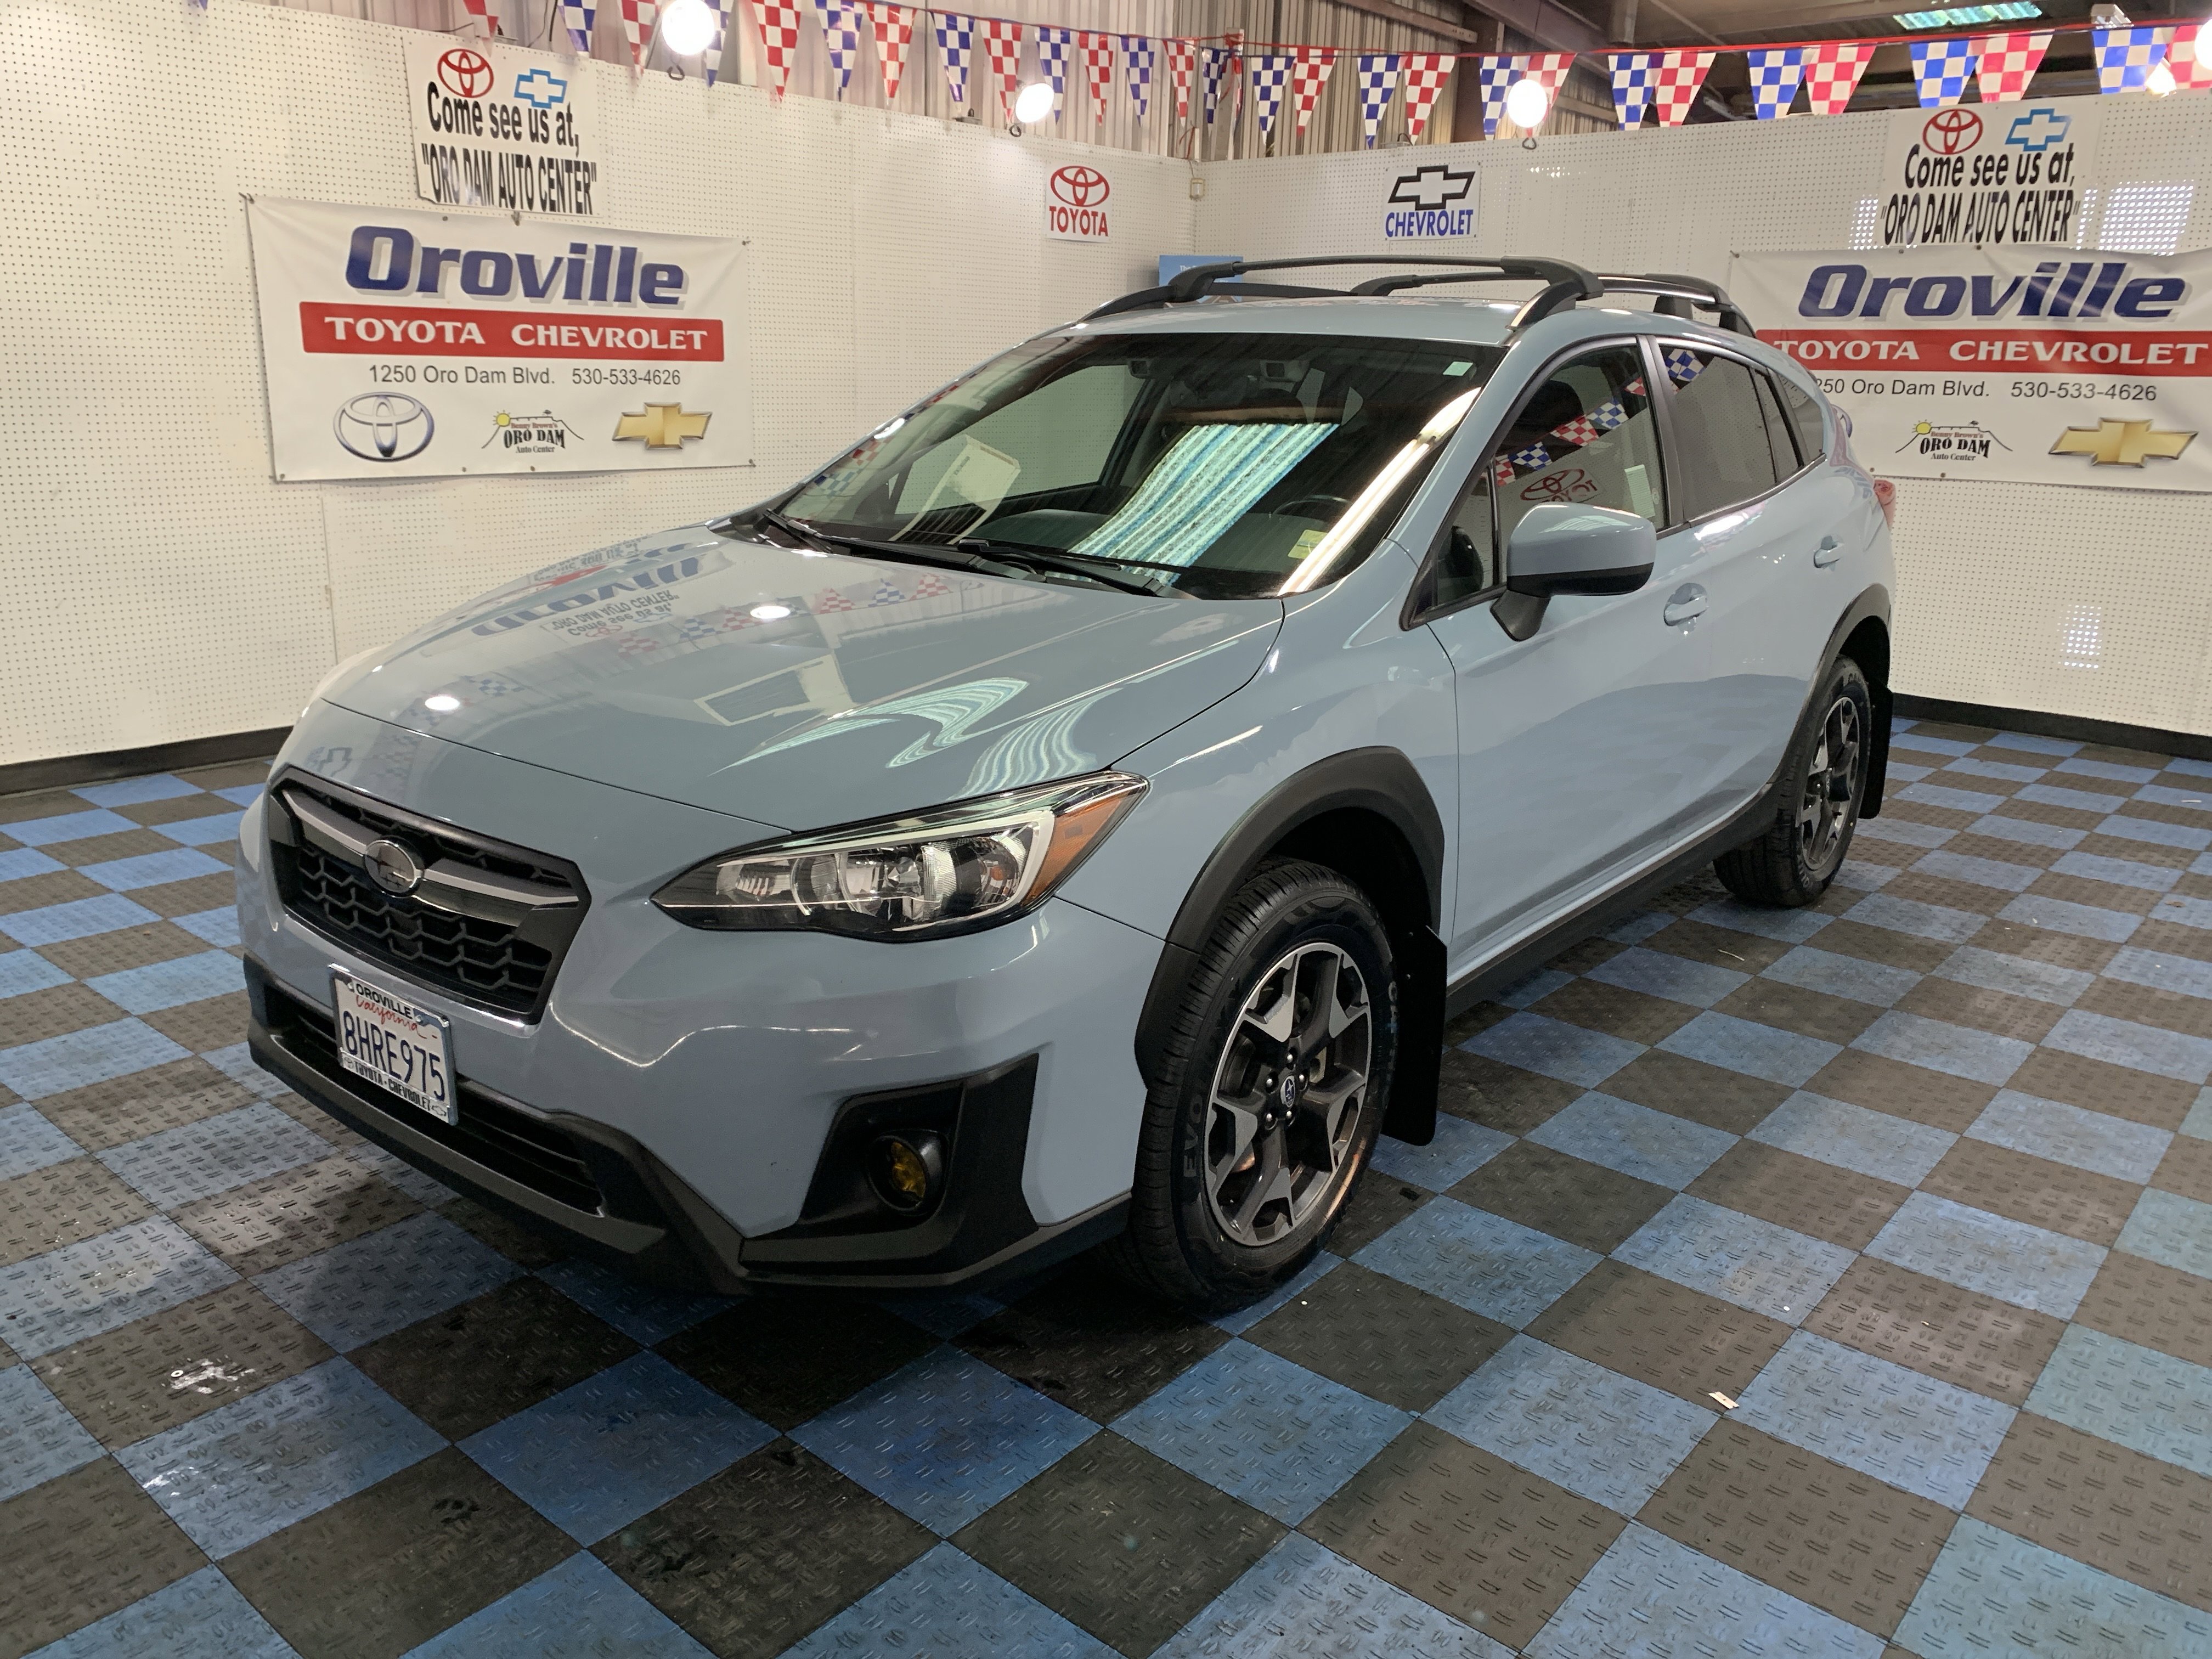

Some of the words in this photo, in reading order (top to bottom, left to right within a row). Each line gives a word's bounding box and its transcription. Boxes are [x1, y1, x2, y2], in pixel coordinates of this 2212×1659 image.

[427, 81, 483, 137] Come
[489, 103, 523, 141] see
[528, 108, 549, 144] us
[556, 101, 579, 157] at,
[421, 143, 460, 204] "ORO
[462, 147, 495, 206] DAM
[499, 151, 534, 211] AUTO
[538, 156, 597, 215] CENTER"
[1905, 143, 1965, 189] Come
[1970, 153, 2009, 187] see
[2016, 151, 2041, 185] us
[2048, 142, 2075, 187] at,
[1049, 205, 1109, 237] TOYOTA
[1385, 209, 1474, 238] CHEVROLET
[1921, 193, 1963, 243] DAM
[1964, 189, 2010, 244] AUTO
[2012, 189, 2081, 242] CENTER"
[345, 225, 686, 307] Oroville
[1798, 262, 2188, 319] Oroville
[324, 317, 486, 345] TOYOTA
[511, 324, 708, 351] CHEVROLET
[1774, 340, 1920, 360] TOYOTA
[1949, 341, 2209, 365] CHEVROLET
[369, 364, 417, 382] 1250
[424, 365, 458, 383] Oro
[465, 366, 506, 384] Dam
[512, 367, 556, 385] Blvd.
[571, 368, 681, 386] 530-533-4626
[1852, 379, 1884, 396] Oro
[1891, 380, 1936, 396] Dam
[1942, 381, 1990, 398] Blvd.
[2011, 382, 2158, 402] 530-533-4626
[504, 430, 532, 448] ORO
[537, 430, 566, 449] DAM
[1920, 437, 1953, 454] ORO
[1957, 438, 1991, 458] DAM
[356, 983, 413, 1019] OROVILLE
[356, 995, 427, 1039] California
[343, 1011, 445, 1101] 8HRE975
[354, 1061, 383, 1085] TOYOTA
[388, 1079, 431, 1111] CHEVROLET
